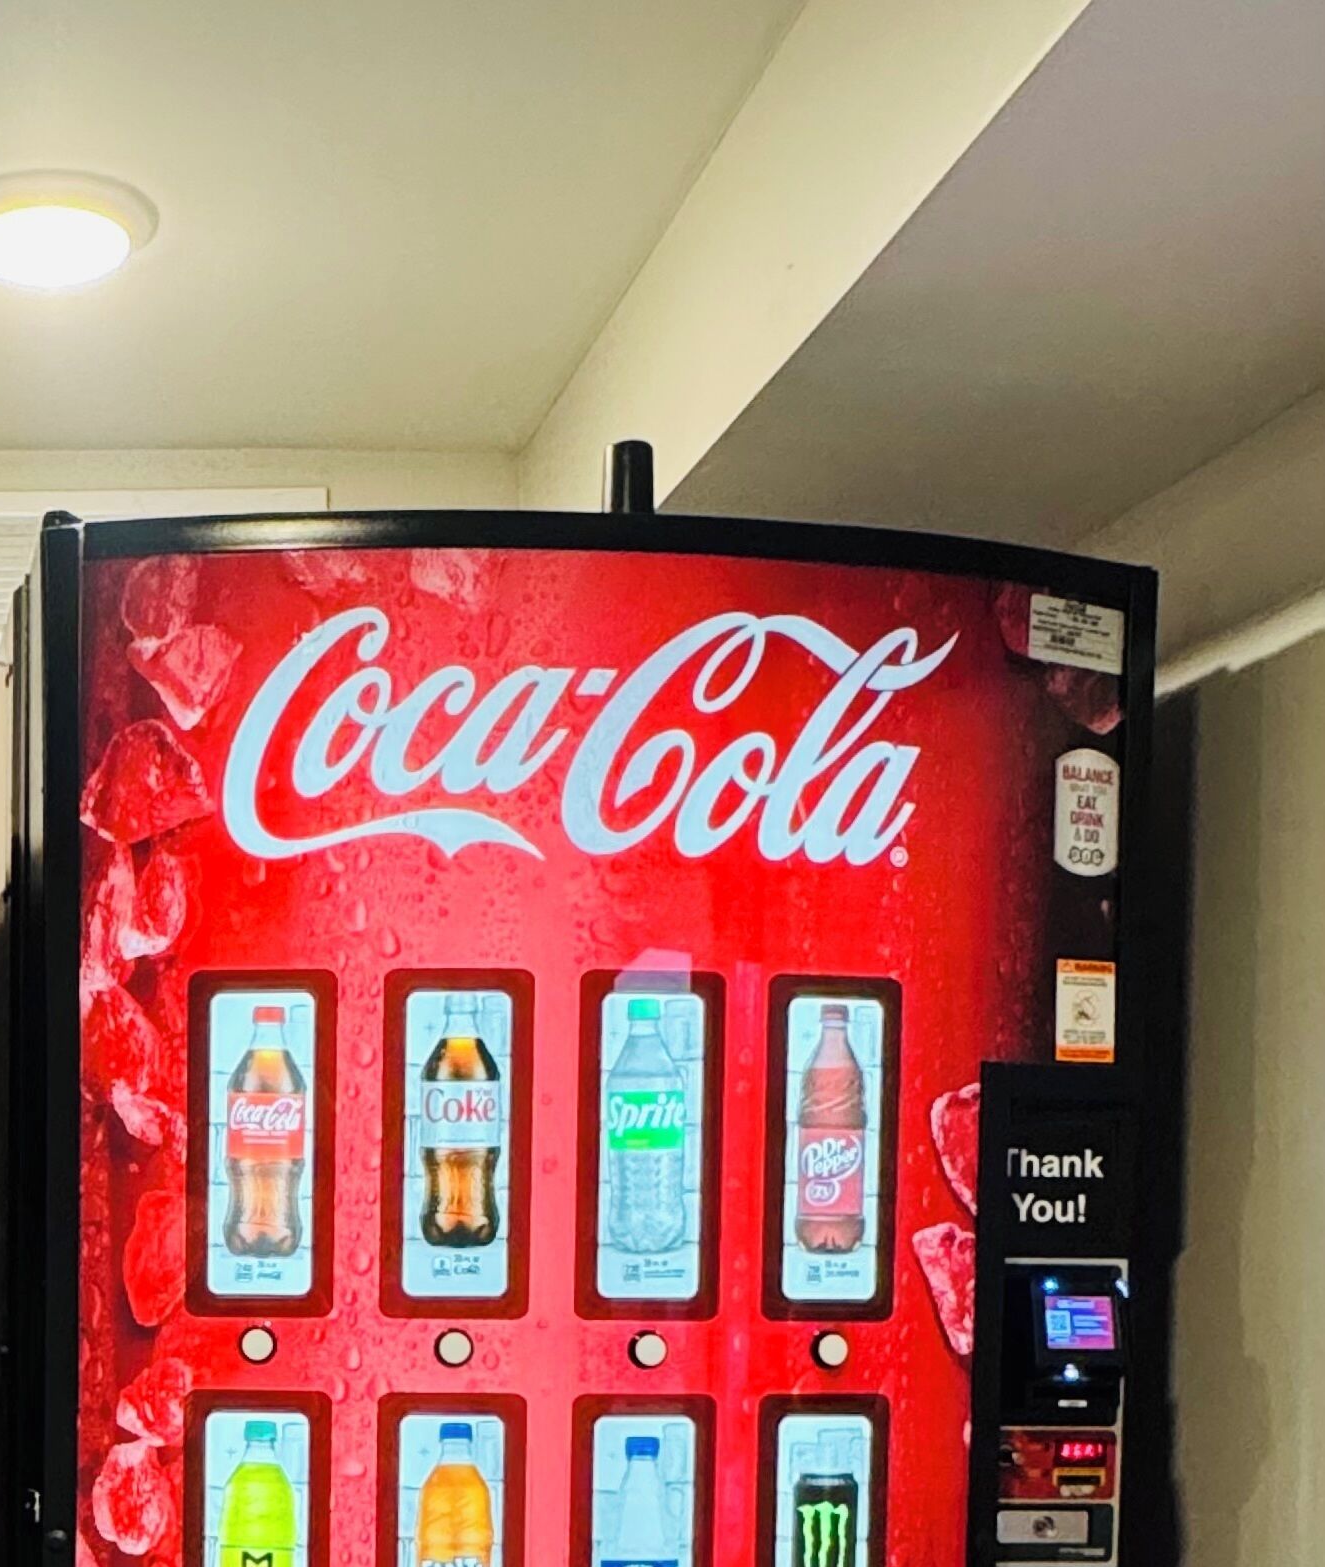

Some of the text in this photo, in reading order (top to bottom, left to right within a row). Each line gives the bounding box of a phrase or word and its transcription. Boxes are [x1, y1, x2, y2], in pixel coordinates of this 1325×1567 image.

[223, 606, 959, 867] Coca-Cola
[1062, 764, 1114, 785] BALANCE
[1077, 794, 1097, 810] EAT
[1070, 810, 1104, 828] DRINK
[1084, 829, 1100, 843] DO
[230, 1096, 302, 1131] Coca-Cola
[425, 1087, 496, 1124] Coke
[608, 1092, 686, 1137] Sprite
[1007, 1147, 1105, 1178] Thank
[1011, 1192, 1087, 1223] You!
